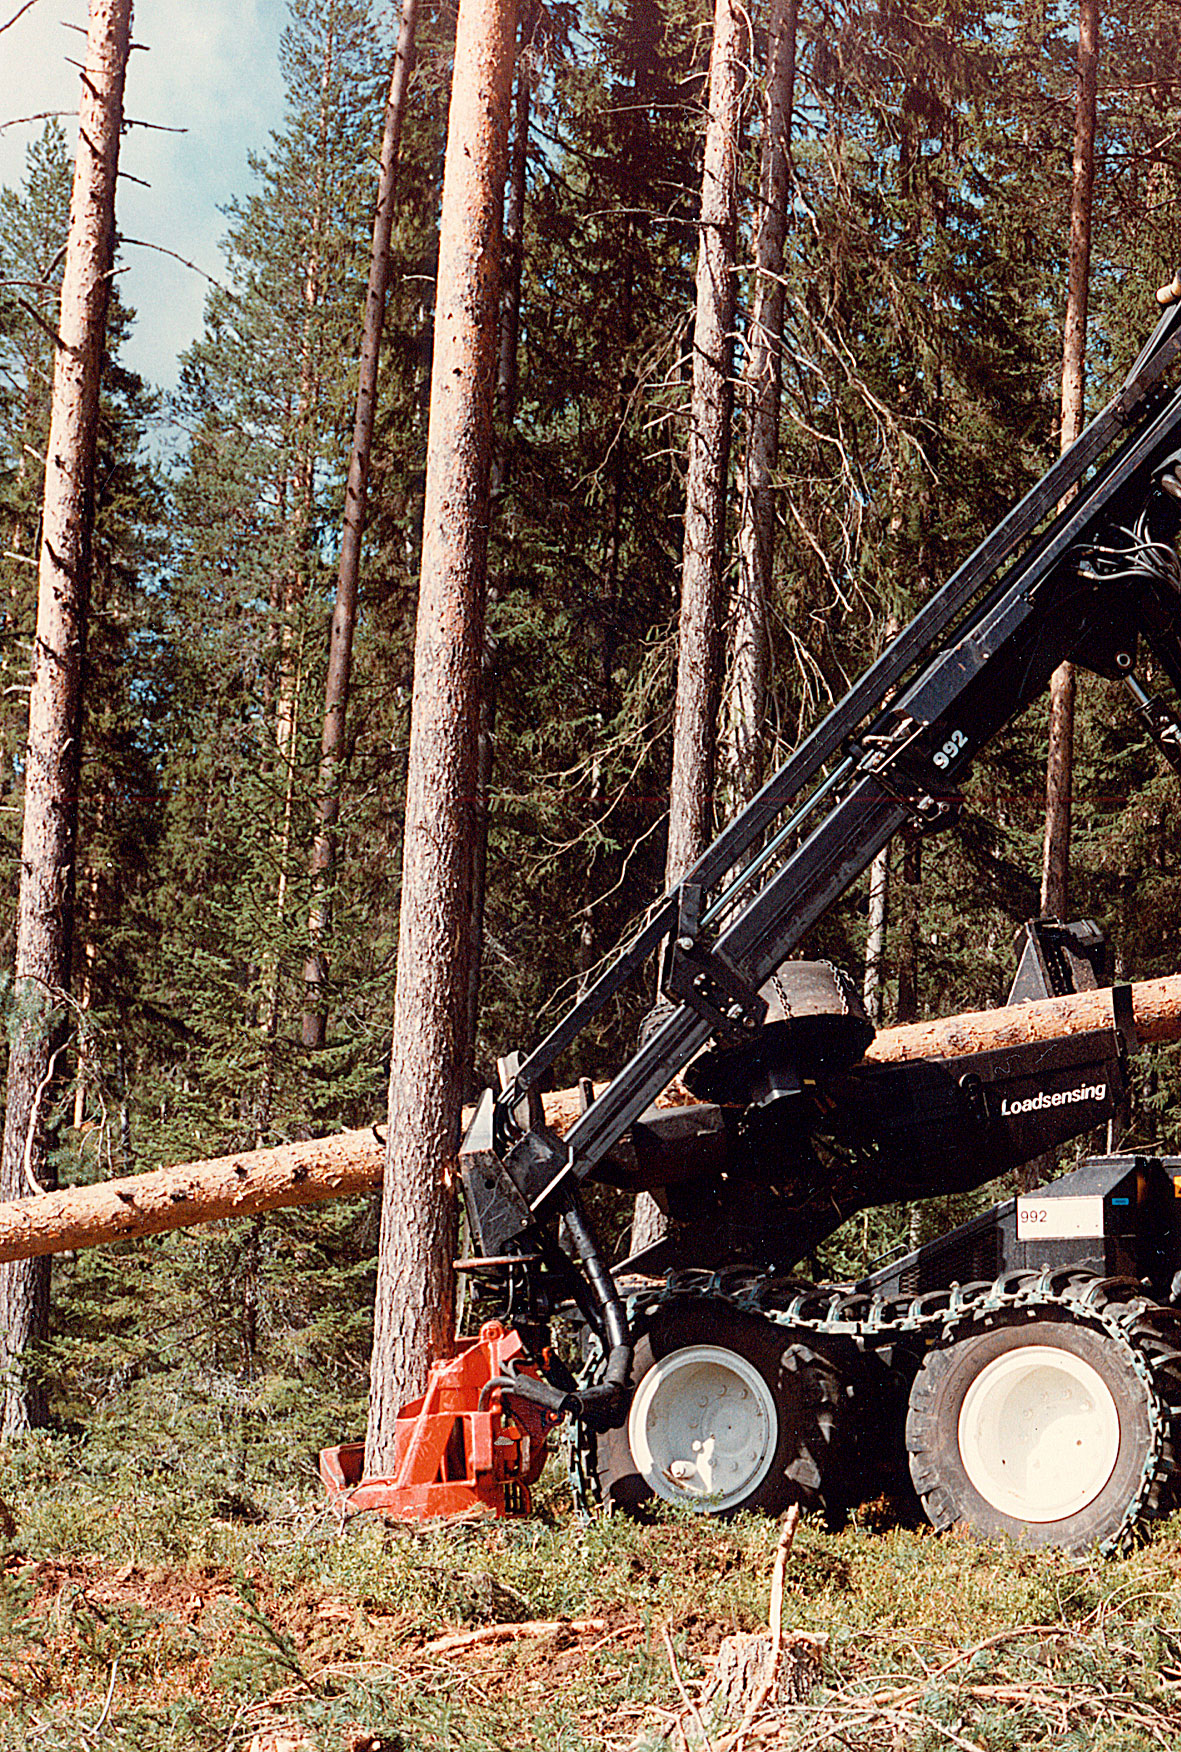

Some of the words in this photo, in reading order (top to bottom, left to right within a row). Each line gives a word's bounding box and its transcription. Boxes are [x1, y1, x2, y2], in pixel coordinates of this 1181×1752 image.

[932, 730, 969, 769] 992
[1001, 1083, 1106, 1116] Loadsensing
[1020, 1210, 1047, 1223] 992
